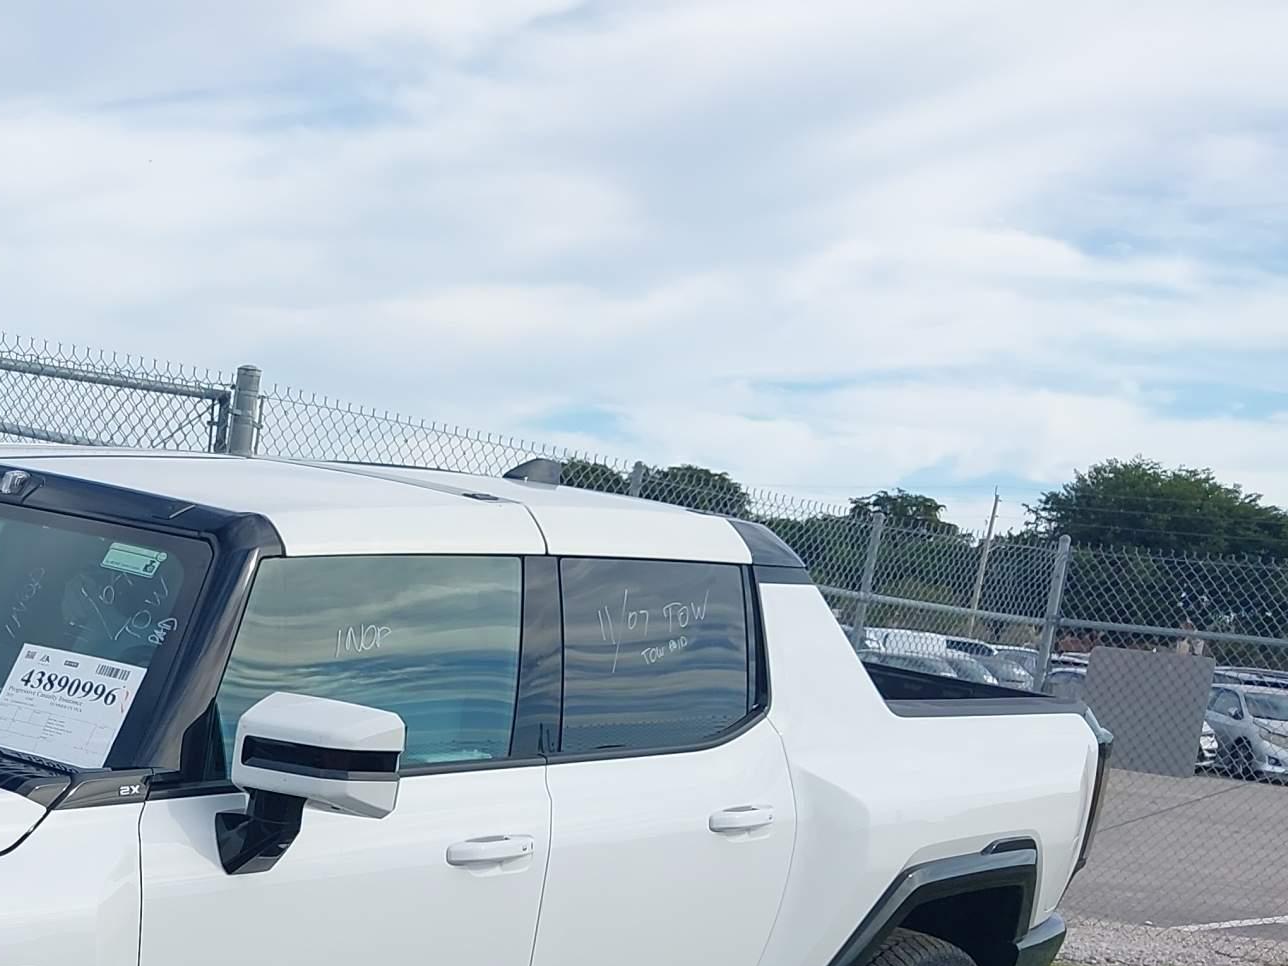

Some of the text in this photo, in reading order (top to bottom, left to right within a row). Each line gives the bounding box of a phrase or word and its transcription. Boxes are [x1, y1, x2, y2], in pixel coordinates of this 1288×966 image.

[597, 588, 709, 673] 11/07 TOW
[641, 646, 665, 665] TOW
[20, 668, 122, 706] 43890996
[119, 784, 141, 796] 2X
